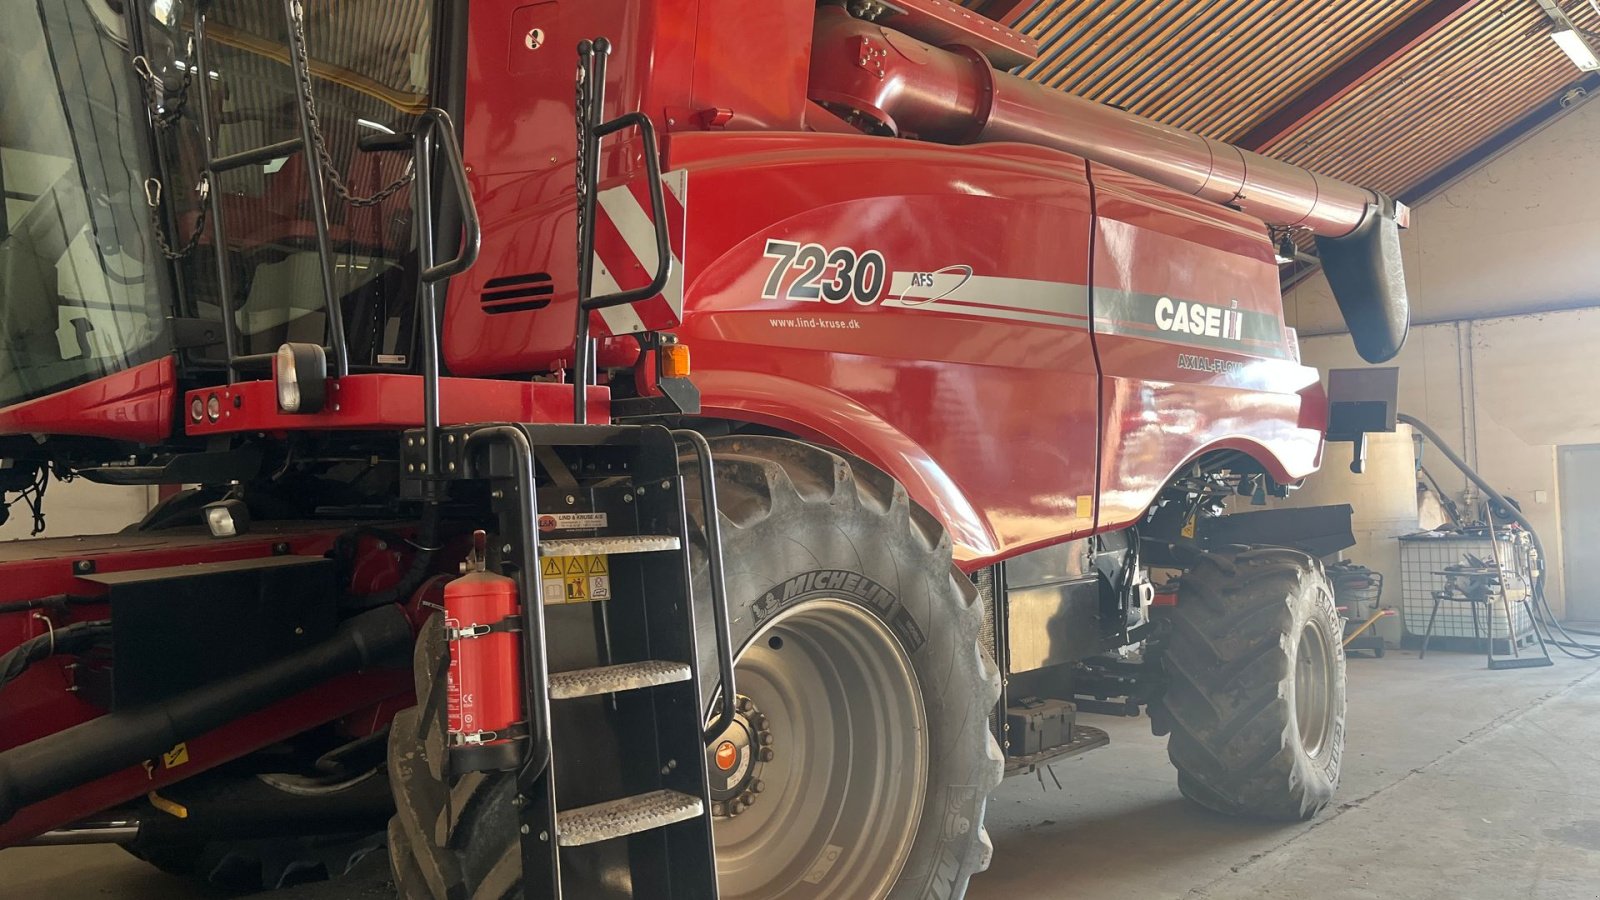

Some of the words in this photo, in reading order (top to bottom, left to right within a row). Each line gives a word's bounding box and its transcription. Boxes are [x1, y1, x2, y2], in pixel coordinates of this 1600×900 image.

[761, 238, 886, 306] 7230
[911, 272, 934, 288] AFS
[769, 317, 861, 330] www.lind-kruse.dk
[1154, 296, 1221, 338] CASE
[782, 570, 895, 609] MICHELIN
